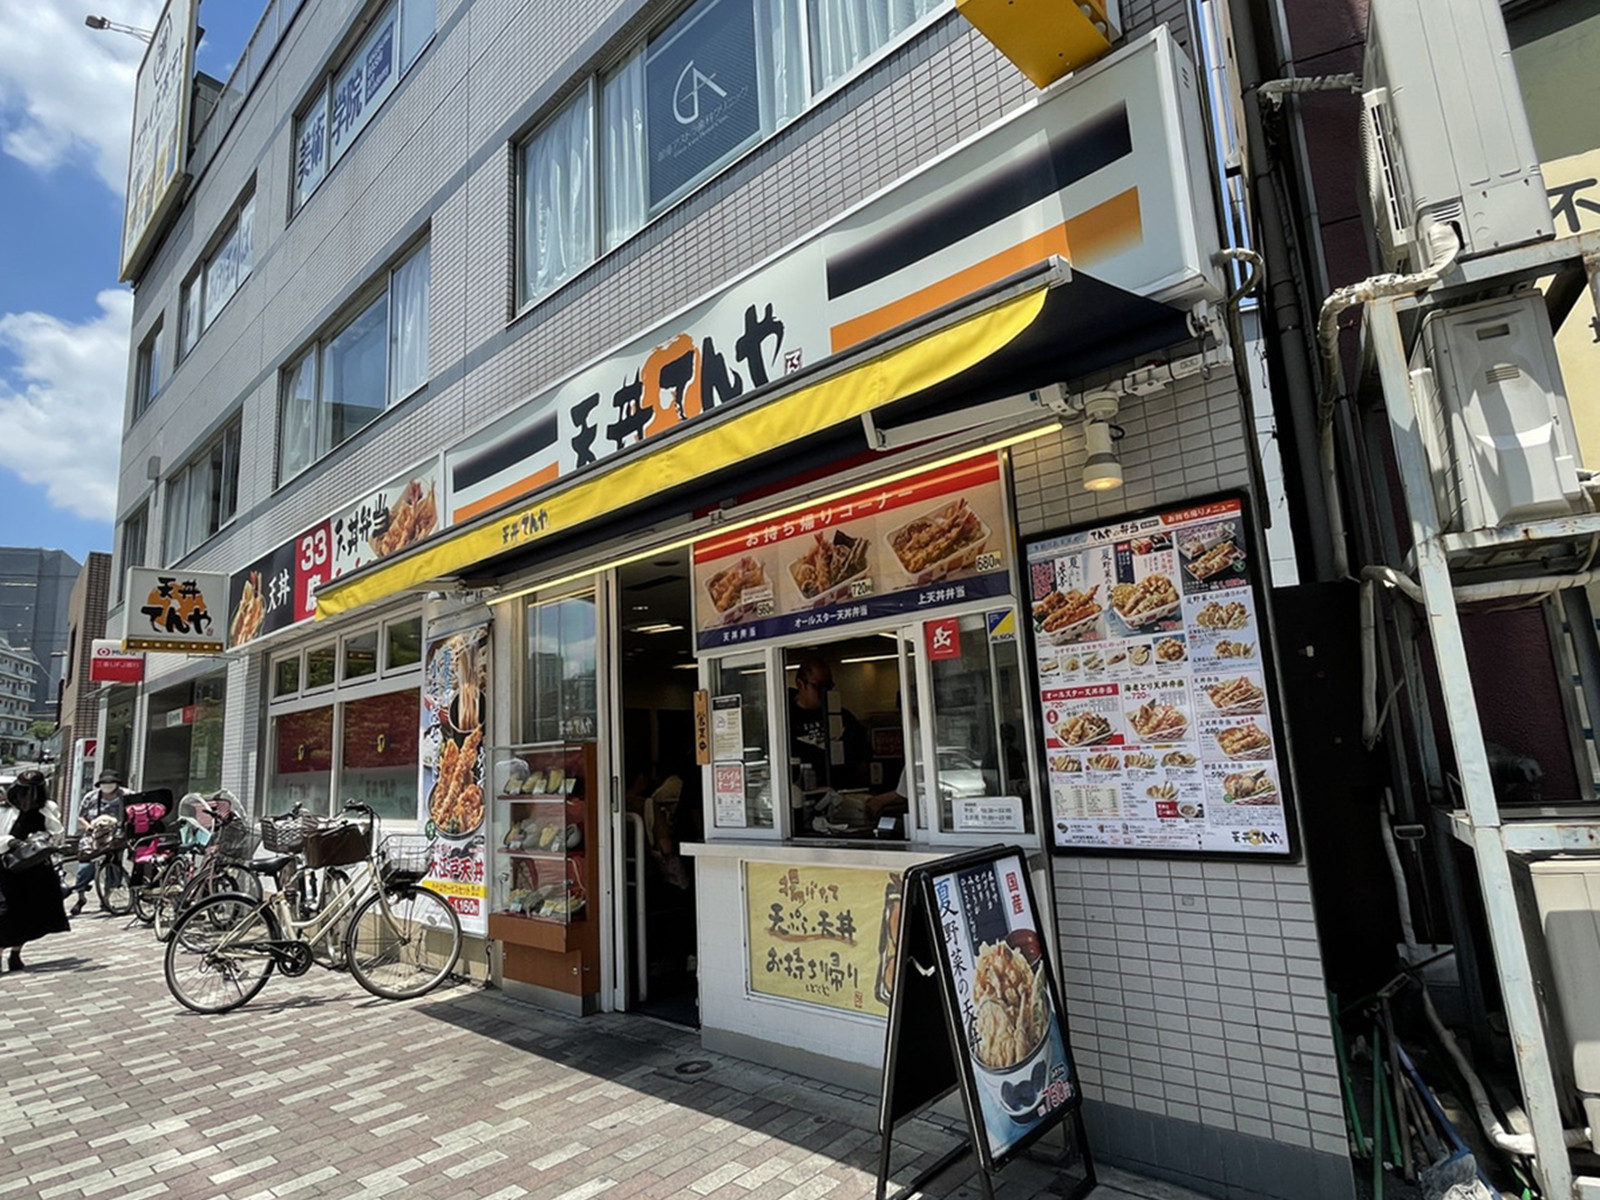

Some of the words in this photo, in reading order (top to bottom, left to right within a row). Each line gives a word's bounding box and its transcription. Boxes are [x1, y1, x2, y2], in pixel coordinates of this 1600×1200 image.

[746, 490, 913, 547] お持ち帰りコーナー
[1168, 503, 1236, 523] お持ち帰りメニュー
[334, 493, 390, 561] 天丼弁当
[300, 528, 328, 572] 33
[154, 577, 200, 599] 天丼
[267, 568, 290, 613] 天丼
[918, 585, 966, 605] 上天丼弁当
[140, 606, 212, 634] てんや
[795, 605, 868, 628] オールスター天丼弁当
[722, 627, 757, 642] 天丼弁当
[1045, 686, 1113, 700] オールスター天丼弁当
[428, 858, 484, 882] 大江戸天丼
[766, 947, 858, 992] お持ち帰り
